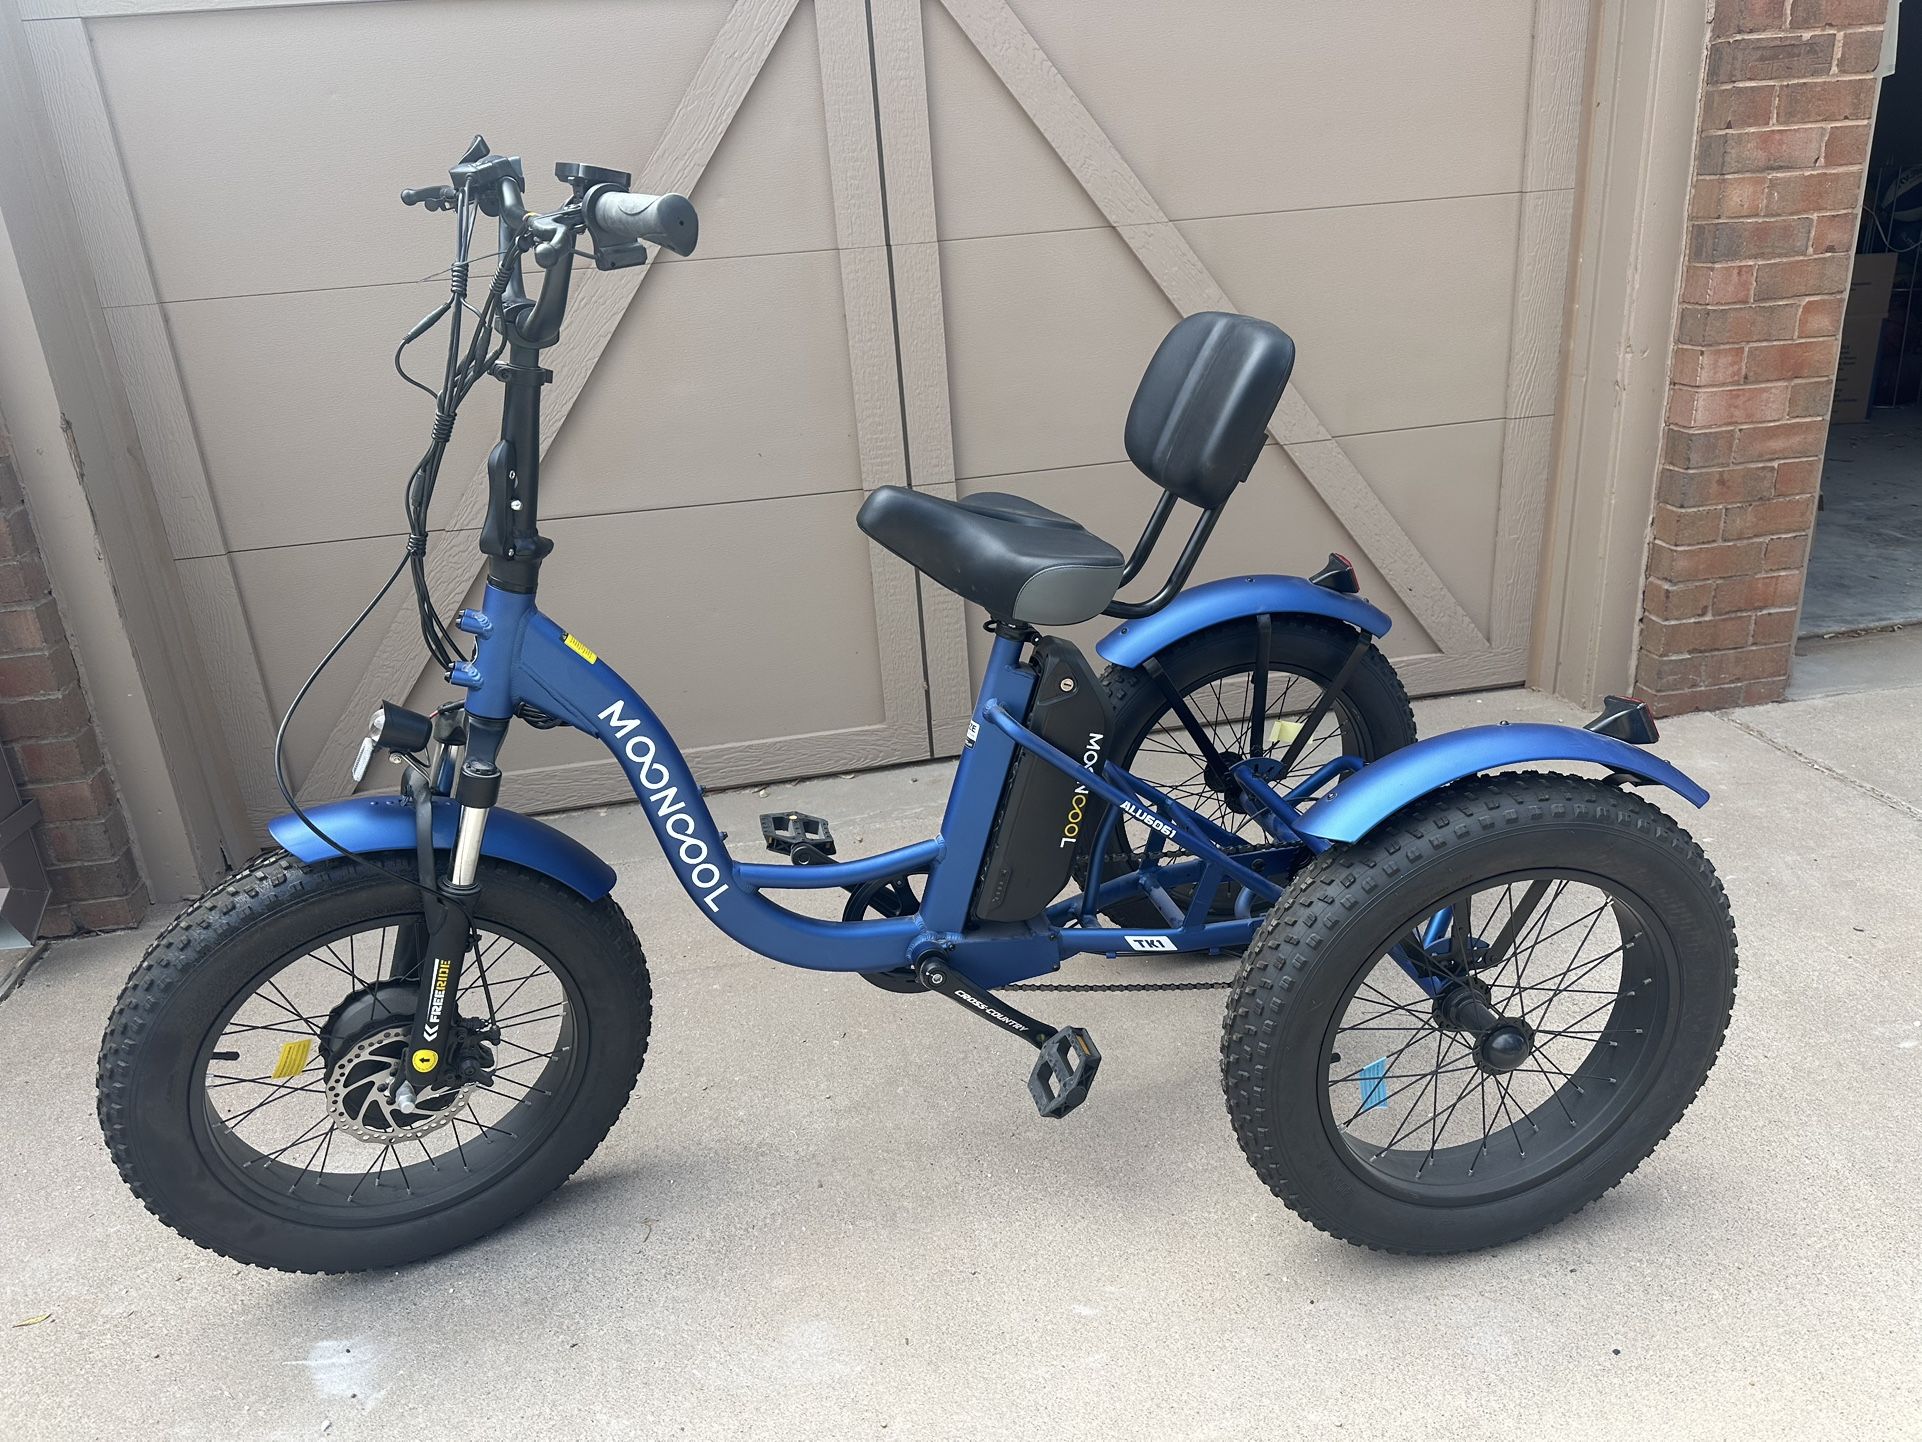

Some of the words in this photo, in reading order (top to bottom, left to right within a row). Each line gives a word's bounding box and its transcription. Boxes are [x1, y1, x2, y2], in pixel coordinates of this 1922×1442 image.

[597, 699, 729, 913] MOONCOOL
[1059, 732, 1104, 848] MONCOOL
[1120, 800, 1177, 839] ALU6061
[1132, 939, 1166, 949] TK1
[429, 959, 451, 1023] FREERIDE
